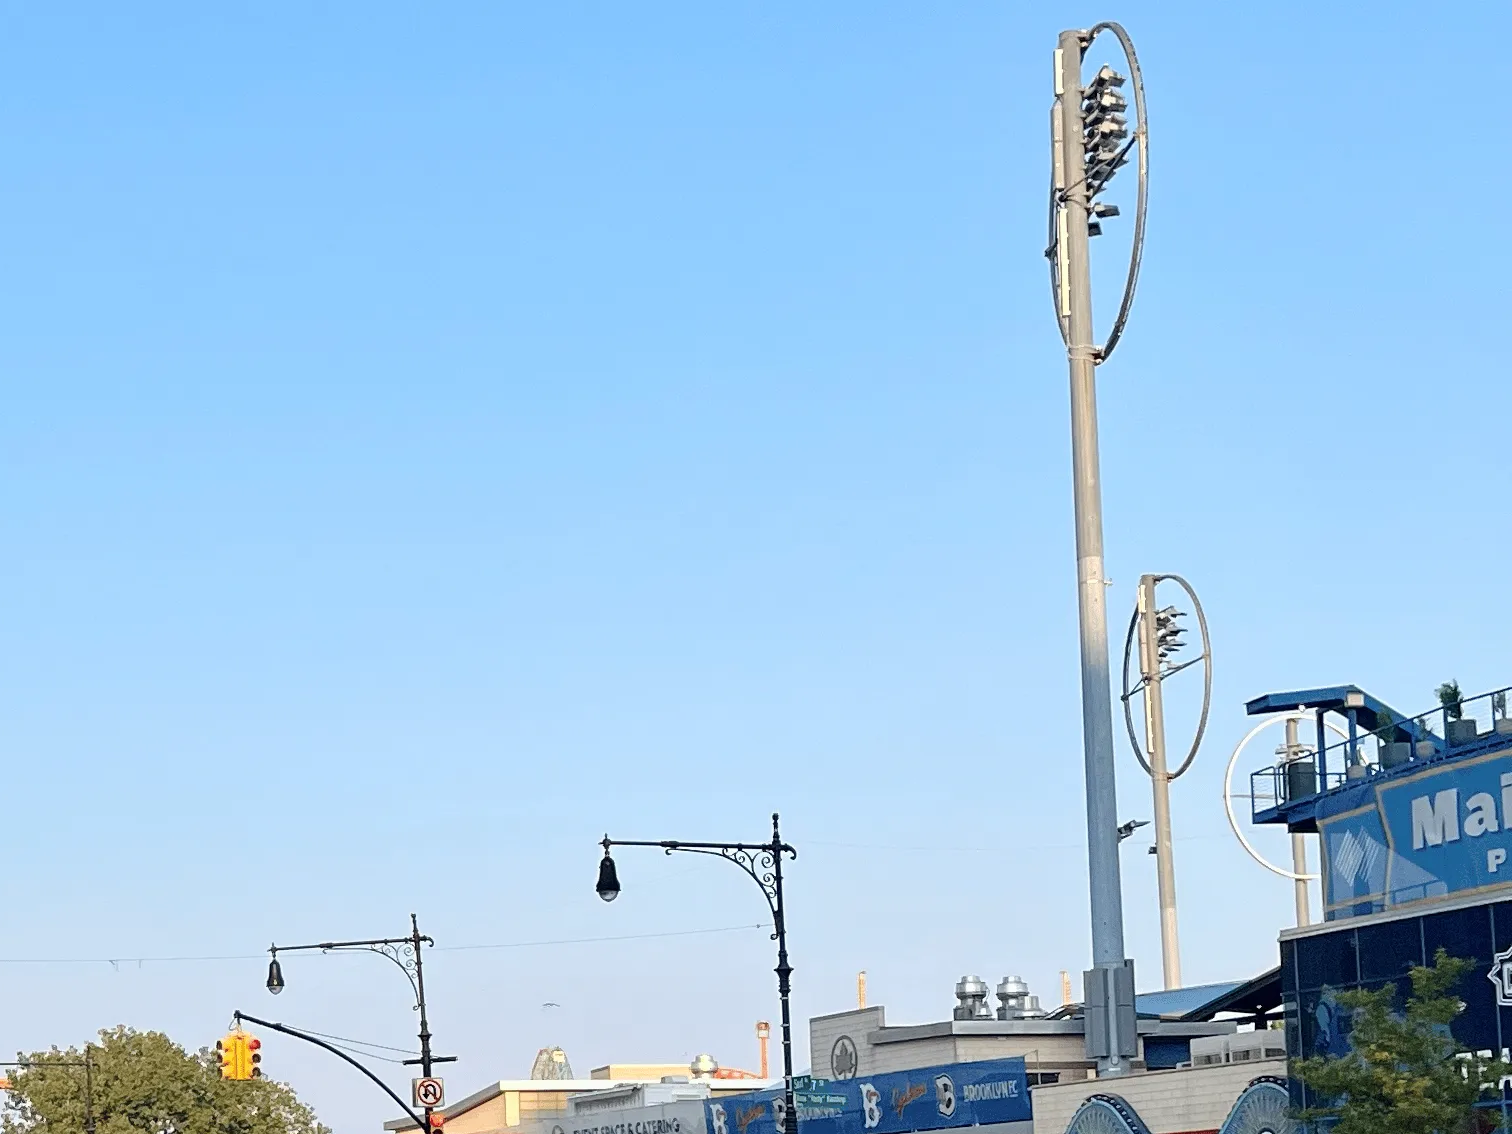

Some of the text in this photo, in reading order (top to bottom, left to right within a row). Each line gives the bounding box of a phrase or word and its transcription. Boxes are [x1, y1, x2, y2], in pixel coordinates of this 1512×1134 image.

[1487, 848, 1507, 873] P
[936, 1073, 956, 1118] B
[963, 1083, 1008, 1102] BROOKLYN
